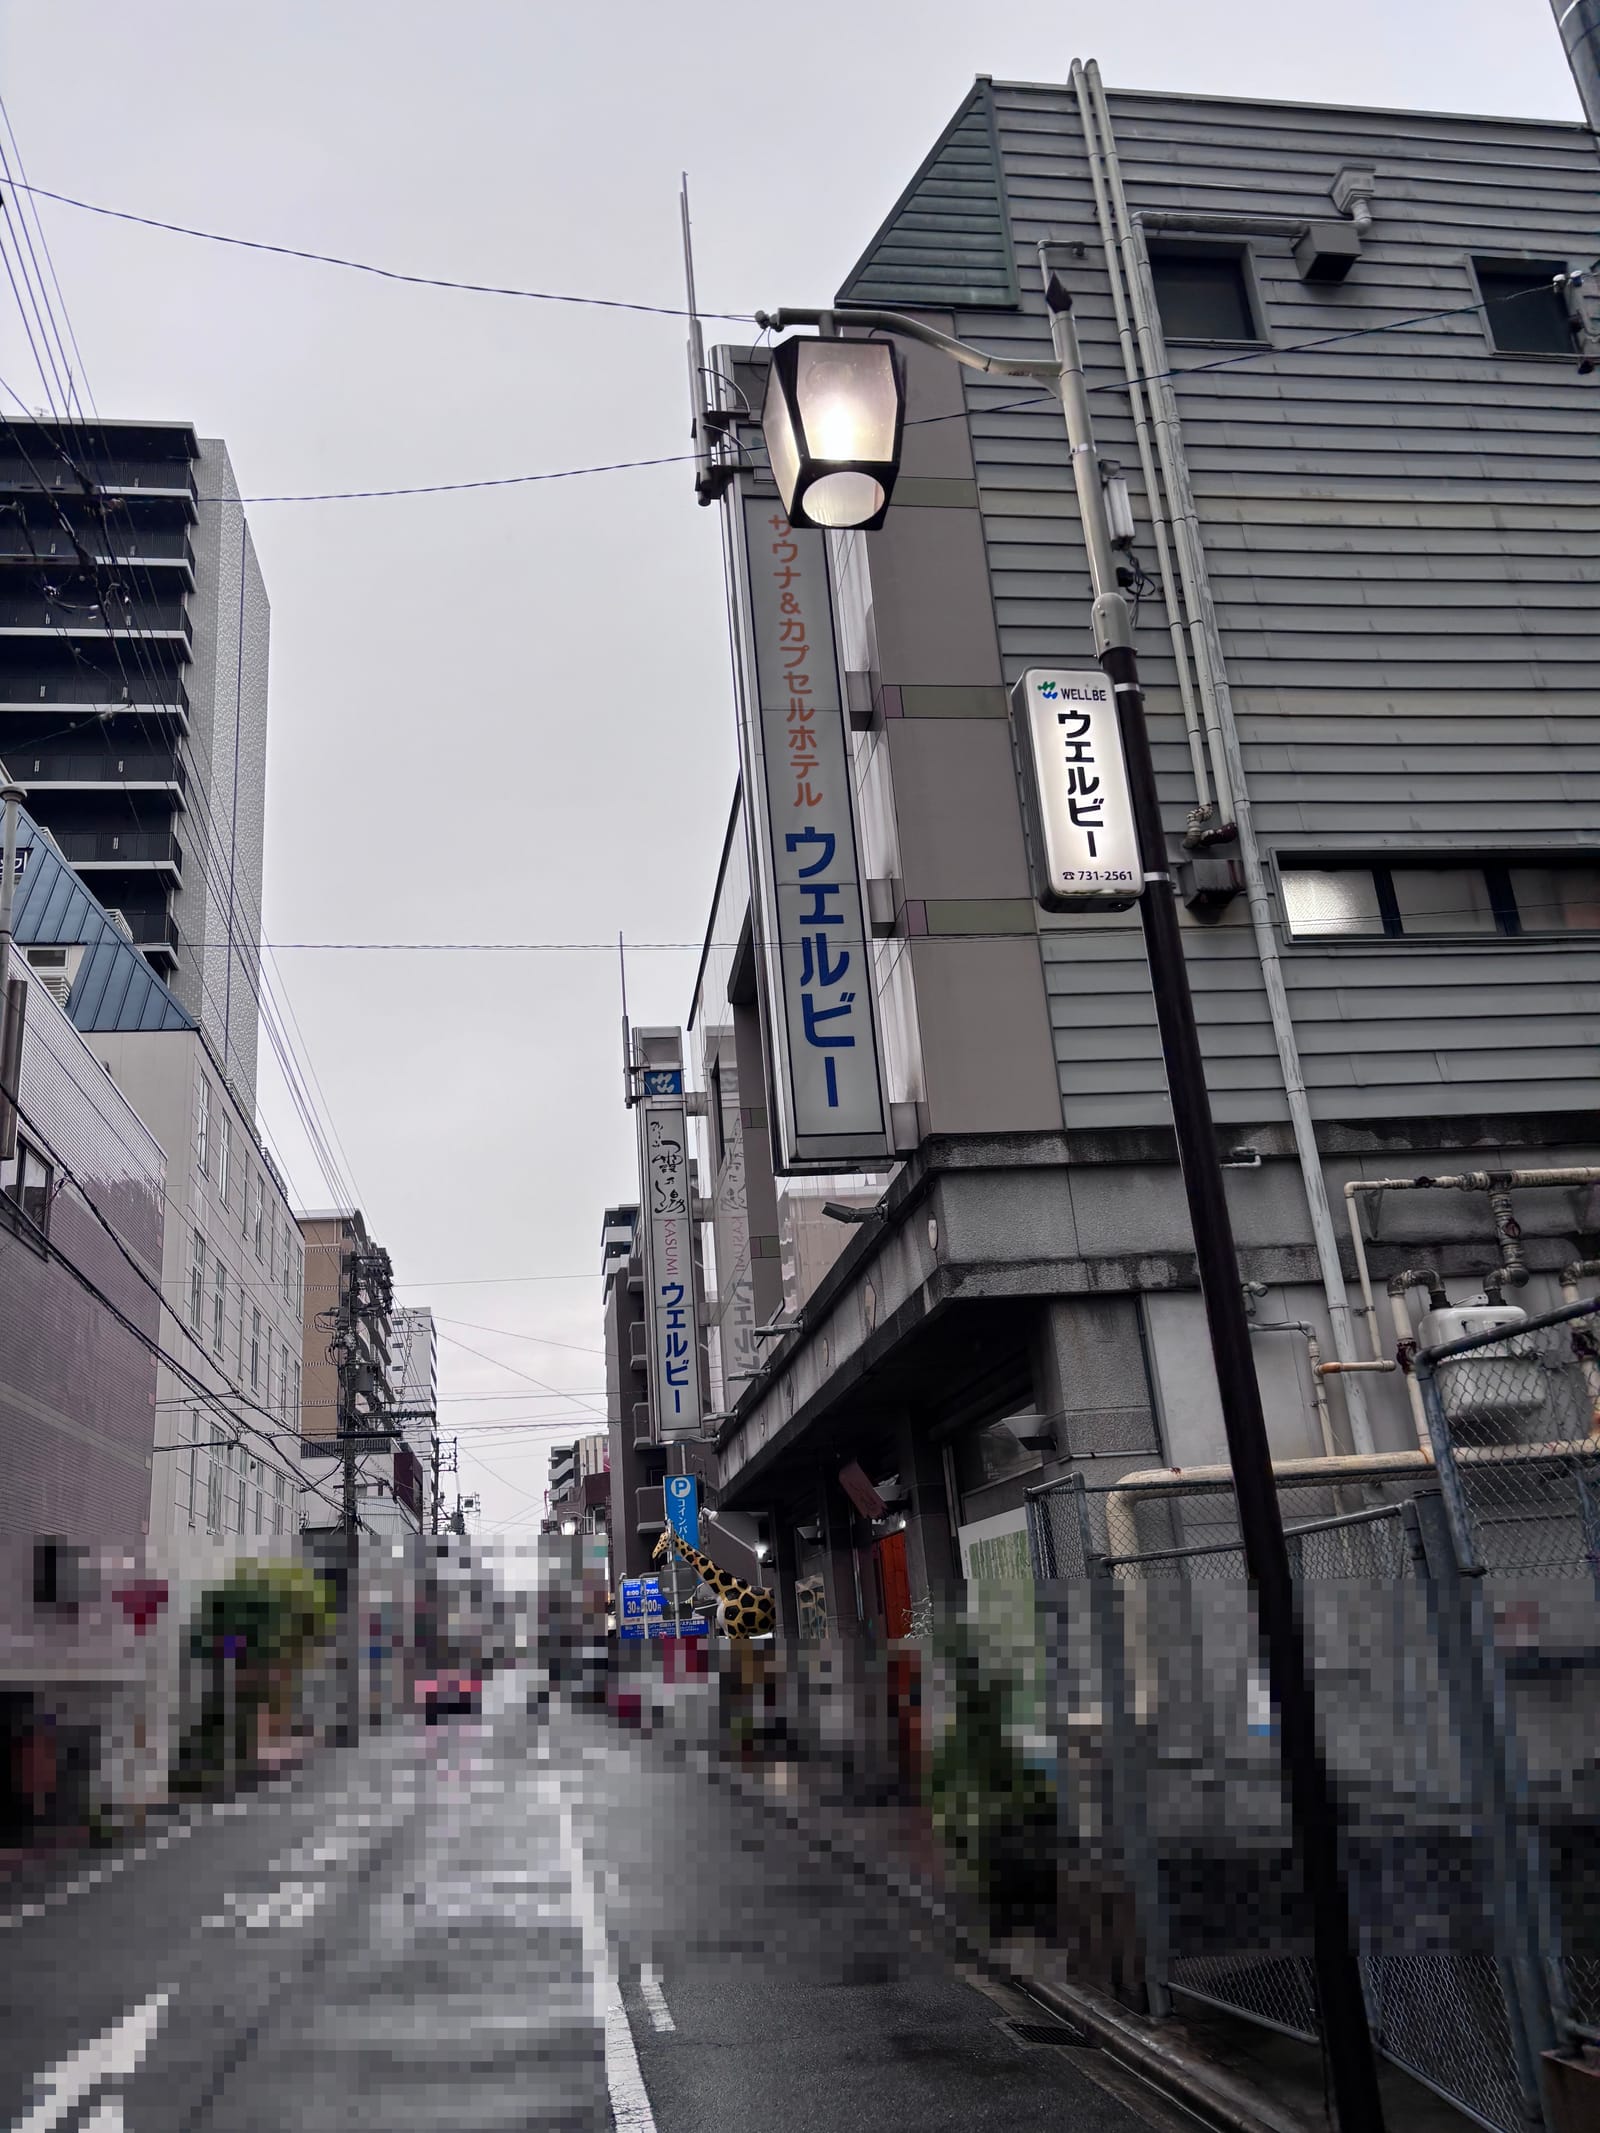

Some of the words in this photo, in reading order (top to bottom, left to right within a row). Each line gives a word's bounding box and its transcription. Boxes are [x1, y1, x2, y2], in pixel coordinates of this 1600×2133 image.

[1061, 688, 1107, 701] WELLBE
[1077, 870, 1133, 881] 731-2561
[664, 1218, 679, 1276] KASUMI
[674, 1480, 688, 1495] P
